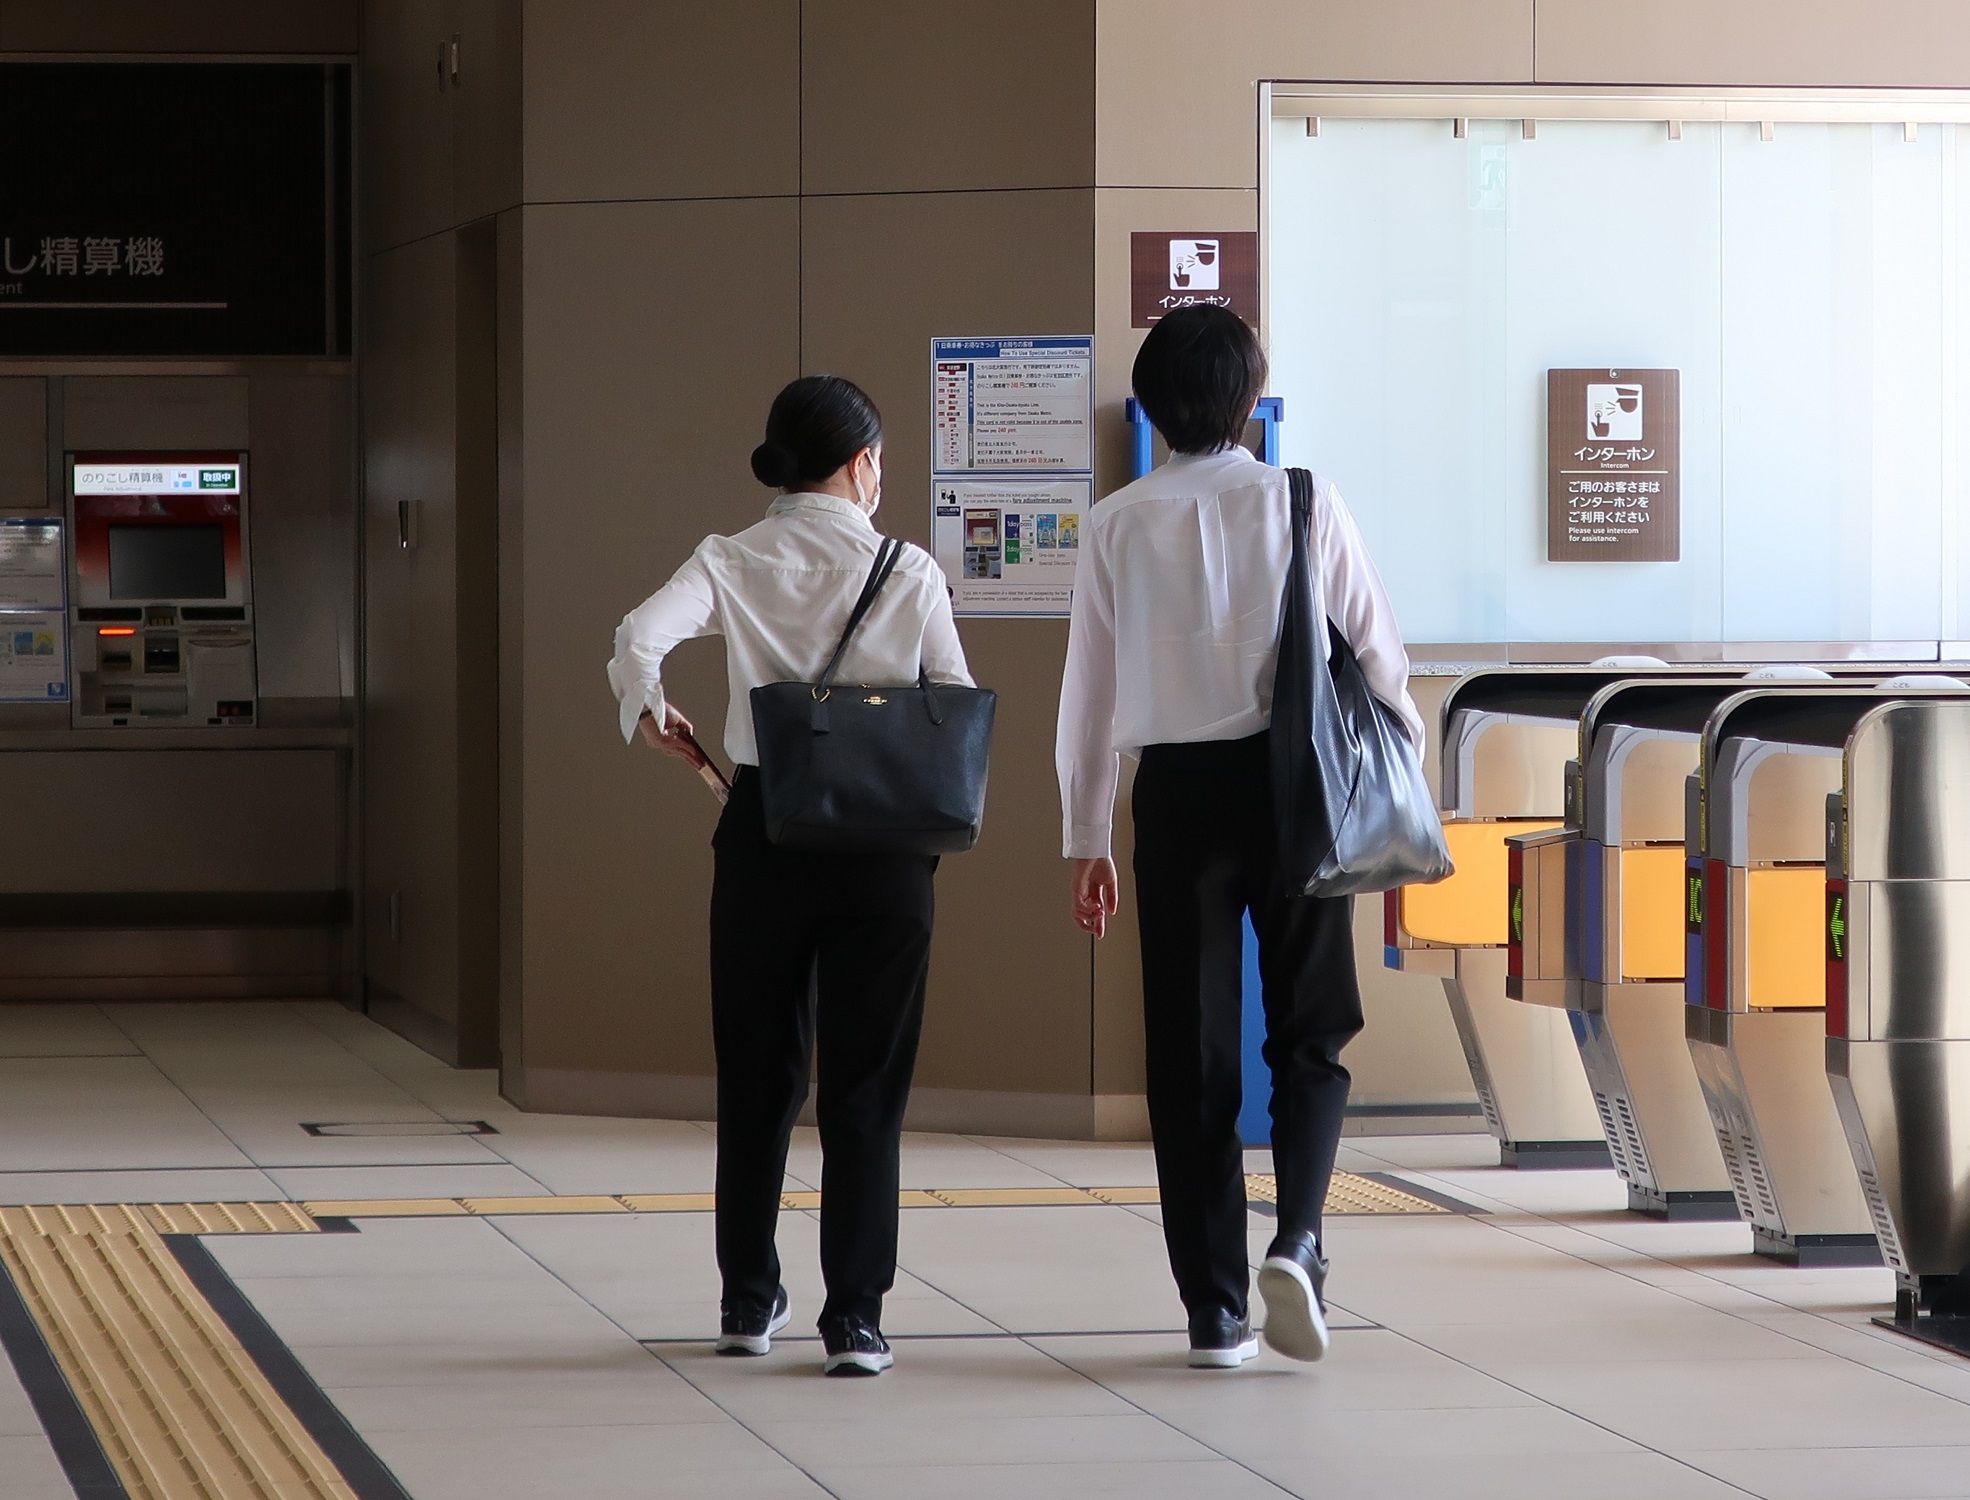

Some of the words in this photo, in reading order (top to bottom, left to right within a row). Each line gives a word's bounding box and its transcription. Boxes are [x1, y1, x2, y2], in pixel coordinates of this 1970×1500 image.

[1574, 447, 1655, 461] インターホン
[82, 472, 163, 484] のりこし精算機
[203, 472, 231, 482] 取扱中
[1568, 481, 1660, 493] ご用のお客さまは
[1569, 497, 1649, 508] インターホンを
[1568, 511, 1650, 523] ご利用ください
